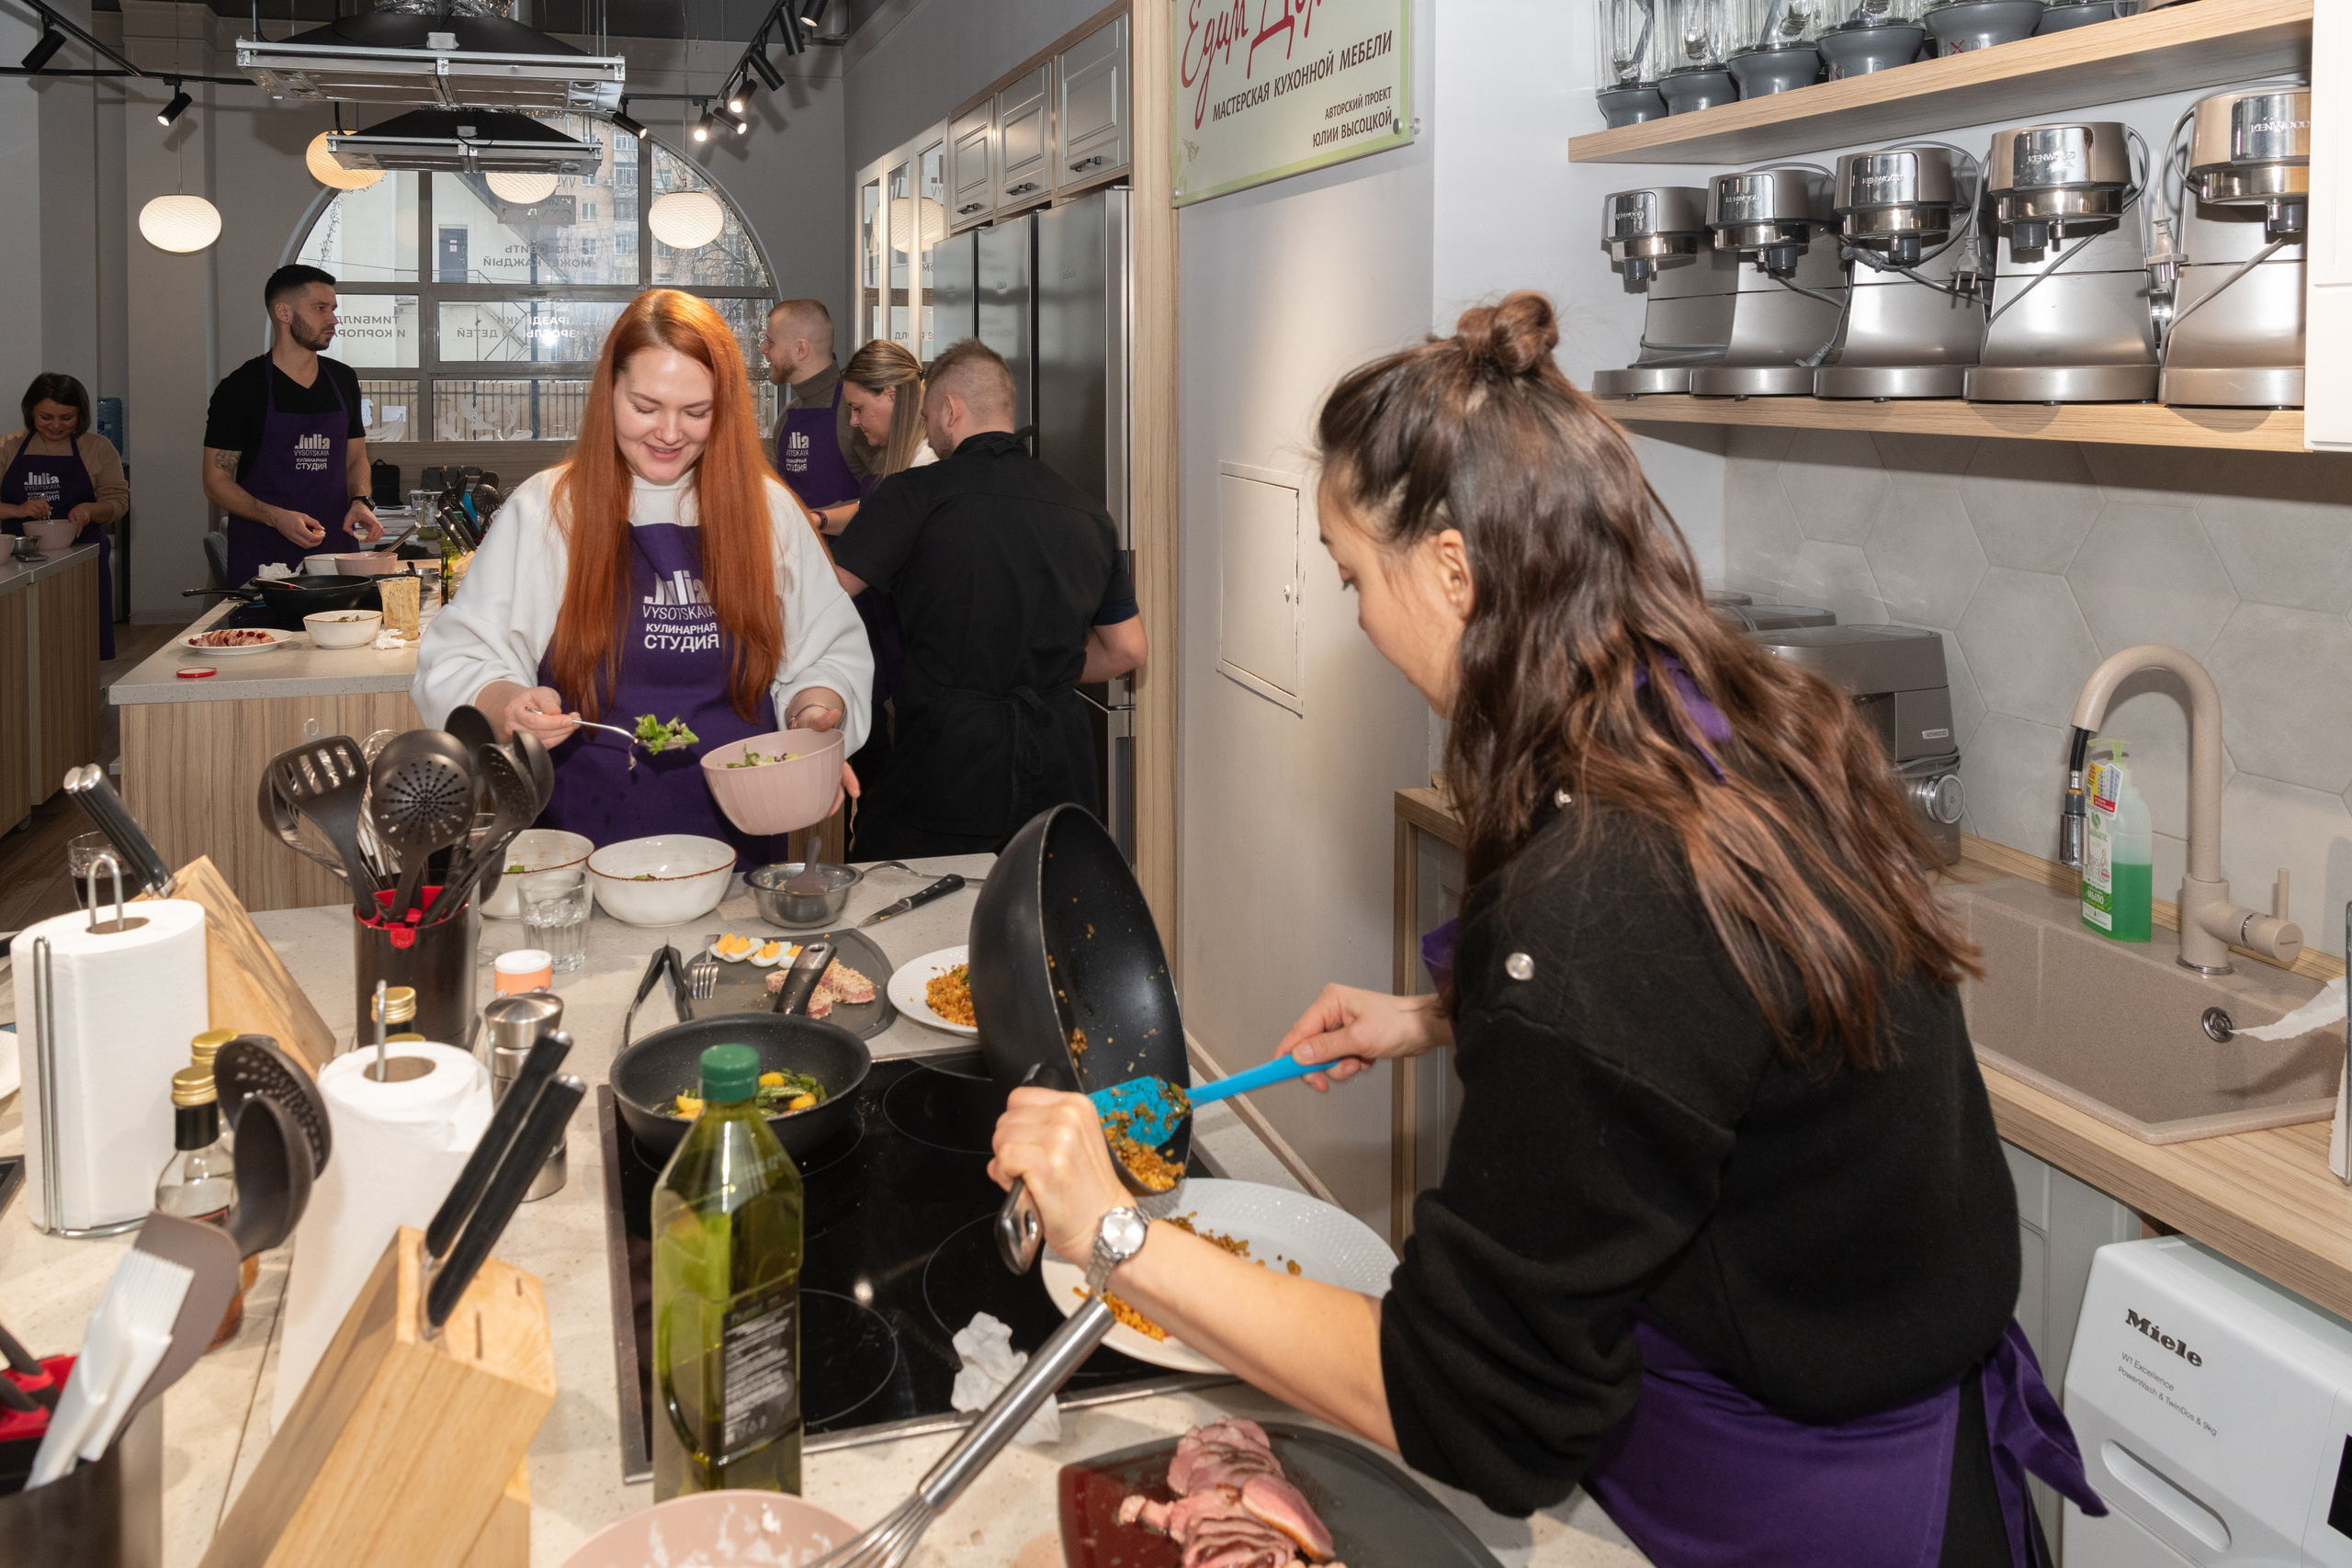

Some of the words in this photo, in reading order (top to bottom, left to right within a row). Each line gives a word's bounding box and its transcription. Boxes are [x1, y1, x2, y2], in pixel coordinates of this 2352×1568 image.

[1213, 82, 1270, 121] МАСТЕРСКАЯ
[1274, 50, 1334, 97] КУХОННОЙ
[1340, 30, 1392, 71] МЕБЕЛИ
[1325, 94, 1363, 119] АВТОРСКИЙ
[1365, 86, 1392, 107] ПРОЕКТ
[1313, 126, 1339, 147] ЮЛИИ
[1341, 106, 1392, 139] ВЫСОЦКОЙ
[2251, 120, 2311, 132] KENWOOD
[294, 434, 331, 449] Julia
[24, 471, 60, 485] Julia
[295, 462, 328, 471] СТУДИЯ
[644, 570, 711, 605] Julia
[643, 605, 717, 621] VYSOTSKAYA
[646, 623, 718, 635] КУЛИНАРНАЯ
[644, 634, 719, 653] СТУДИЯ
[2125, 1308, 2203, 1368] Miele
[2121, 1351, 2133, 1364] W1
[2134, 1360, 2175, 1392] Excellence
[2118, 1366, 2157, 1396] PowerWash
[2165, 1396, 2195, 1421] TwinDos
[2202, 1421, 2218, 1437] 9kg
